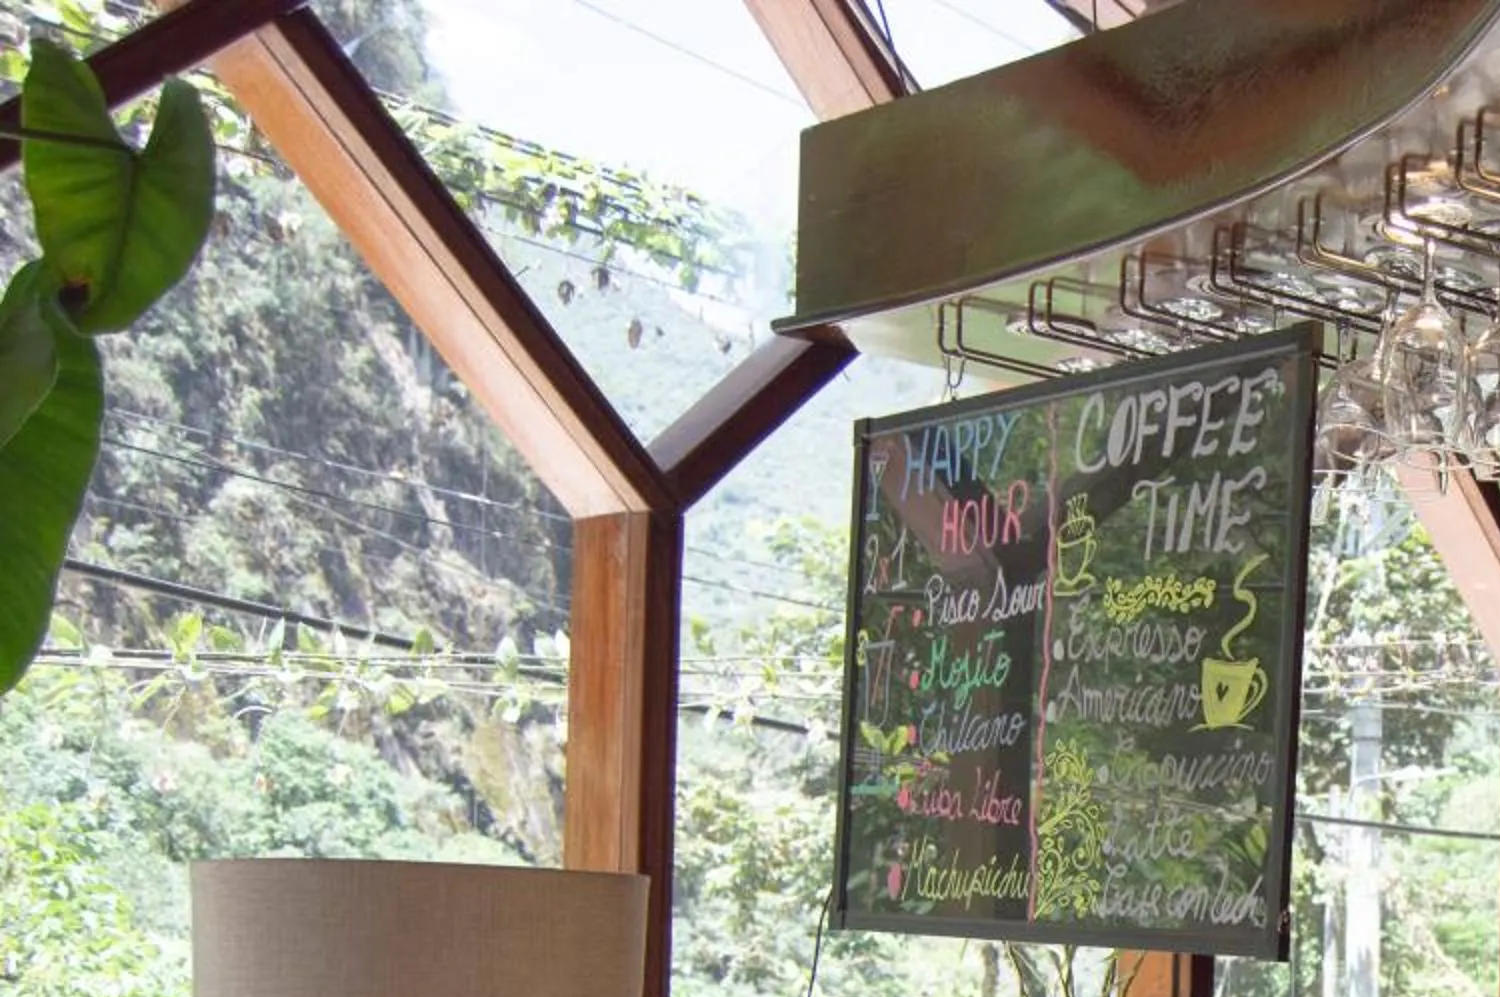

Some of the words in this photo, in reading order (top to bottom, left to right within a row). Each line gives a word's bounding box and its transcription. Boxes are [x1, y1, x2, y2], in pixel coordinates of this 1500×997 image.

[901, 412, 1023, 501] HAPPY
[1075, 367, 1282, 474] COFFEE
[941, 479, 1027, 555] HOUR
[1131, 465, 1267, 561] TIME
[925, 573, 981, 627] Pisco
[982, 564, 1047, 623] Sour
[1067, 594, 1208, 672] Expresso
[921, 628, 1012, 711] Mojito
[1057, 662, 1203, 727] Americano
[920, 696, 1027, 758] Chilcano
